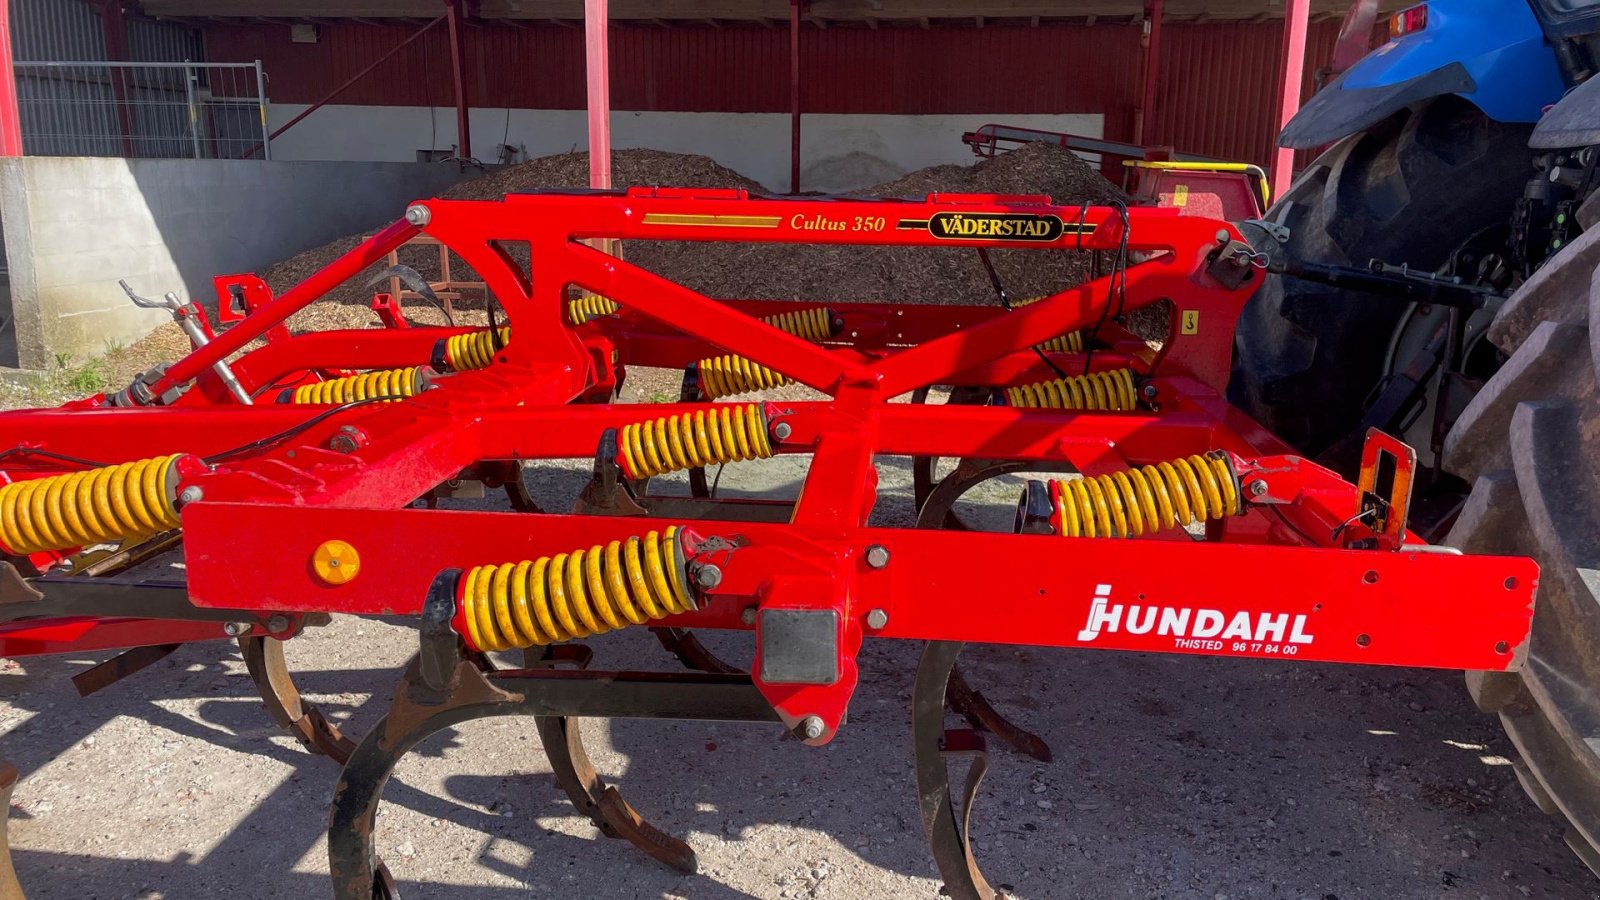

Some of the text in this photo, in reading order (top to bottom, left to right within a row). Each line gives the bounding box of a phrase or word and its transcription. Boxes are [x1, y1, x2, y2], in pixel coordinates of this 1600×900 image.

[790, 213, 886, 233] Cultus 350
[940, 214, 1052, 238] VÄDERSTAD
[1174, 638, 1297, 655] THISTED 96 17 84 00
